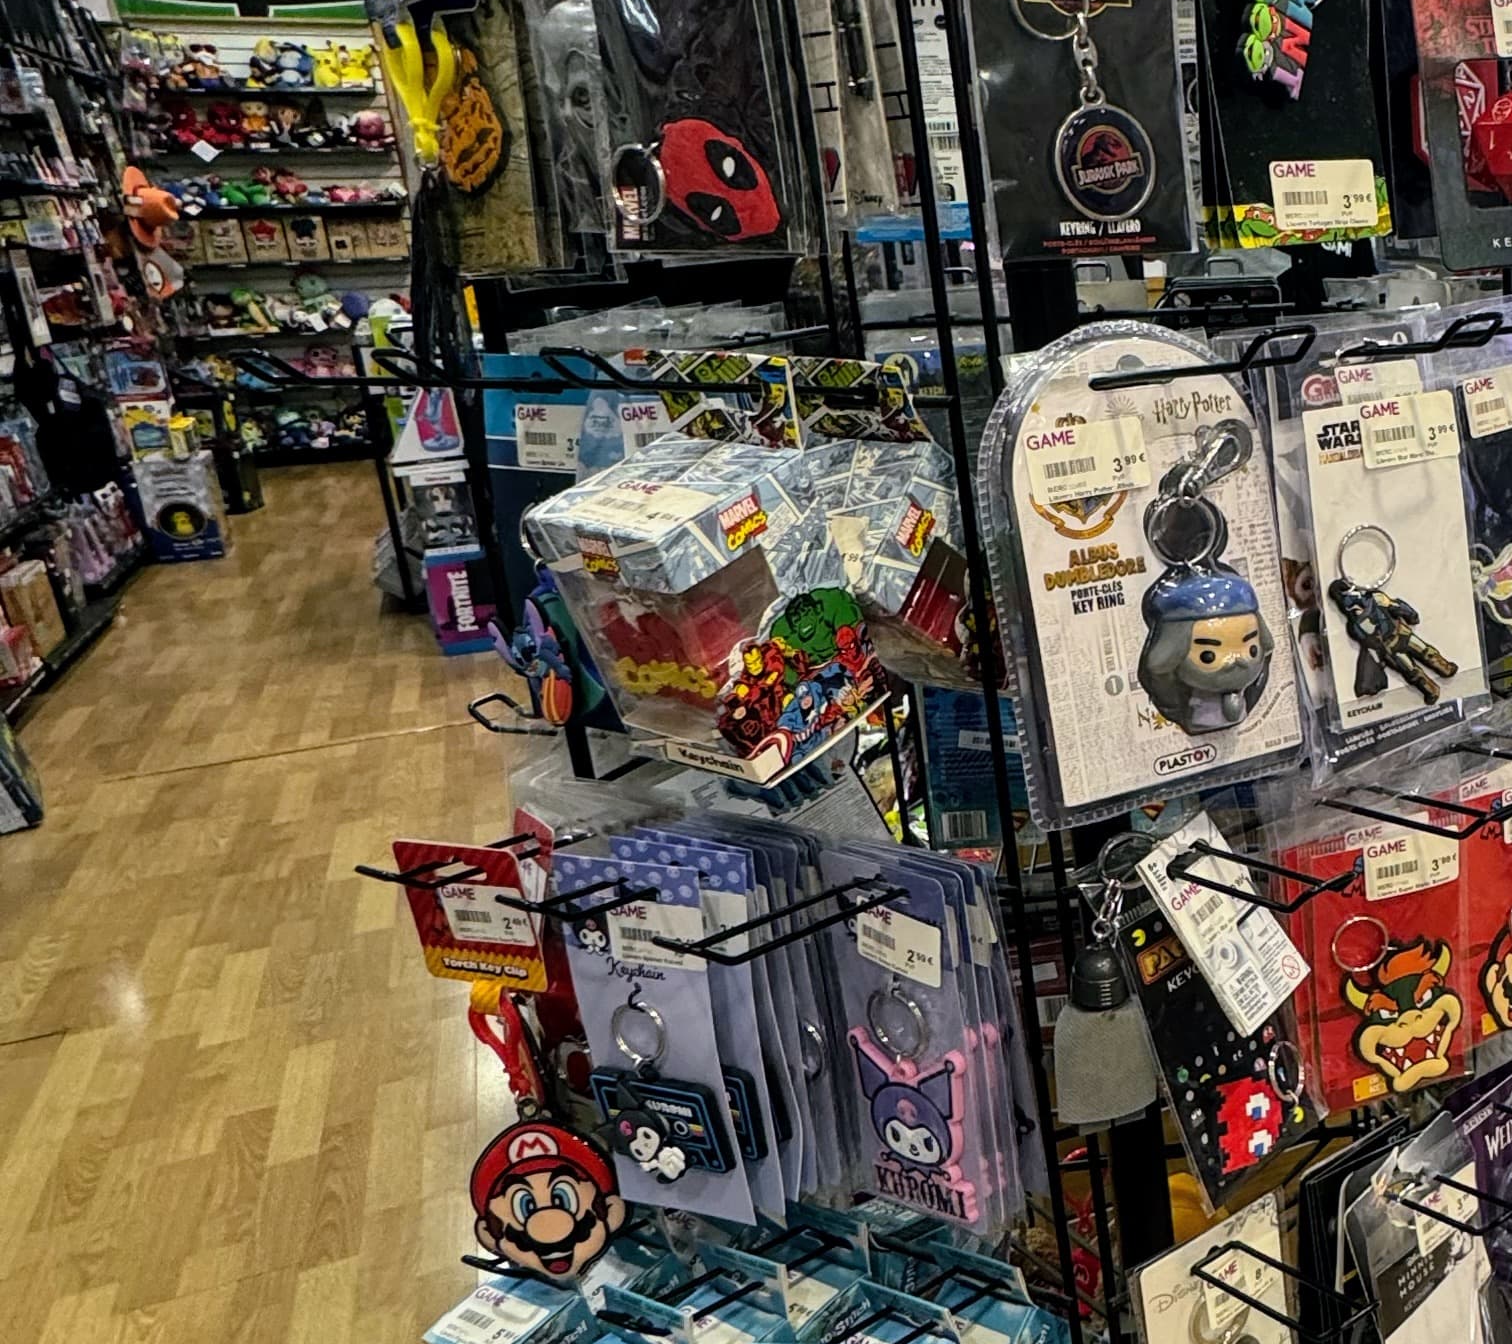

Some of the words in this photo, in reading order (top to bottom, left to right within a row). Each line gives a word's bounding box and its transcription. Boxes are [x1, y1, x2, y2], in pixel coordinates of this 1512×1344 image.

[1115, 161, 1138, 178] PARK
[1273, 163, 1315, 178] GAME
[1060, 221, 1095, 235] KEYRING
[1337, 367, 1373, 384] GAME
[1465, 378, 1494, 395] GAME
[517, 406, 547, 421] GAME
[622, 405, 656, 422] GAME
[1153, 394, 1191, 424] Harry
[1191, 392, 1231, 414] Potter
[1360, 402, 1400, 419] GAME
[1026, 428, 1075, 450] GAME
[617, 480, 662, 495] GAME
[718, 495, 759, 531] MARVEL
[727, 510, 766, 550] COMICS
[896, 504, 921, 546] MARVEL
[910, 511, 931, 557] COMICS
[1069, 543, 1120, 569] ALBUS
[1044, 556, 1147, 591] DUMBLEDORE
[457, 569, 479, 632] FORTNITE
[1073, 597, 1096, 615] KEY
[1098, 594, 1125, 612] RING
[1159, 748, 1213, 771] PLASTOY
[1367, 840, 1407, 858] GAME
[442, 884, 476, 901] GAME
[443, 956, 477, 974] Torch
[478, 960, 499, 978] Key
[502, 964, 528, 980] Clip
[607, 957, 665, 982] Keychain
[876, 1164, 966, 1216] KUROMI
[1399, 1266, 1435, 1298] MOUSE
[475, 1286, 508, 1307] GAME
